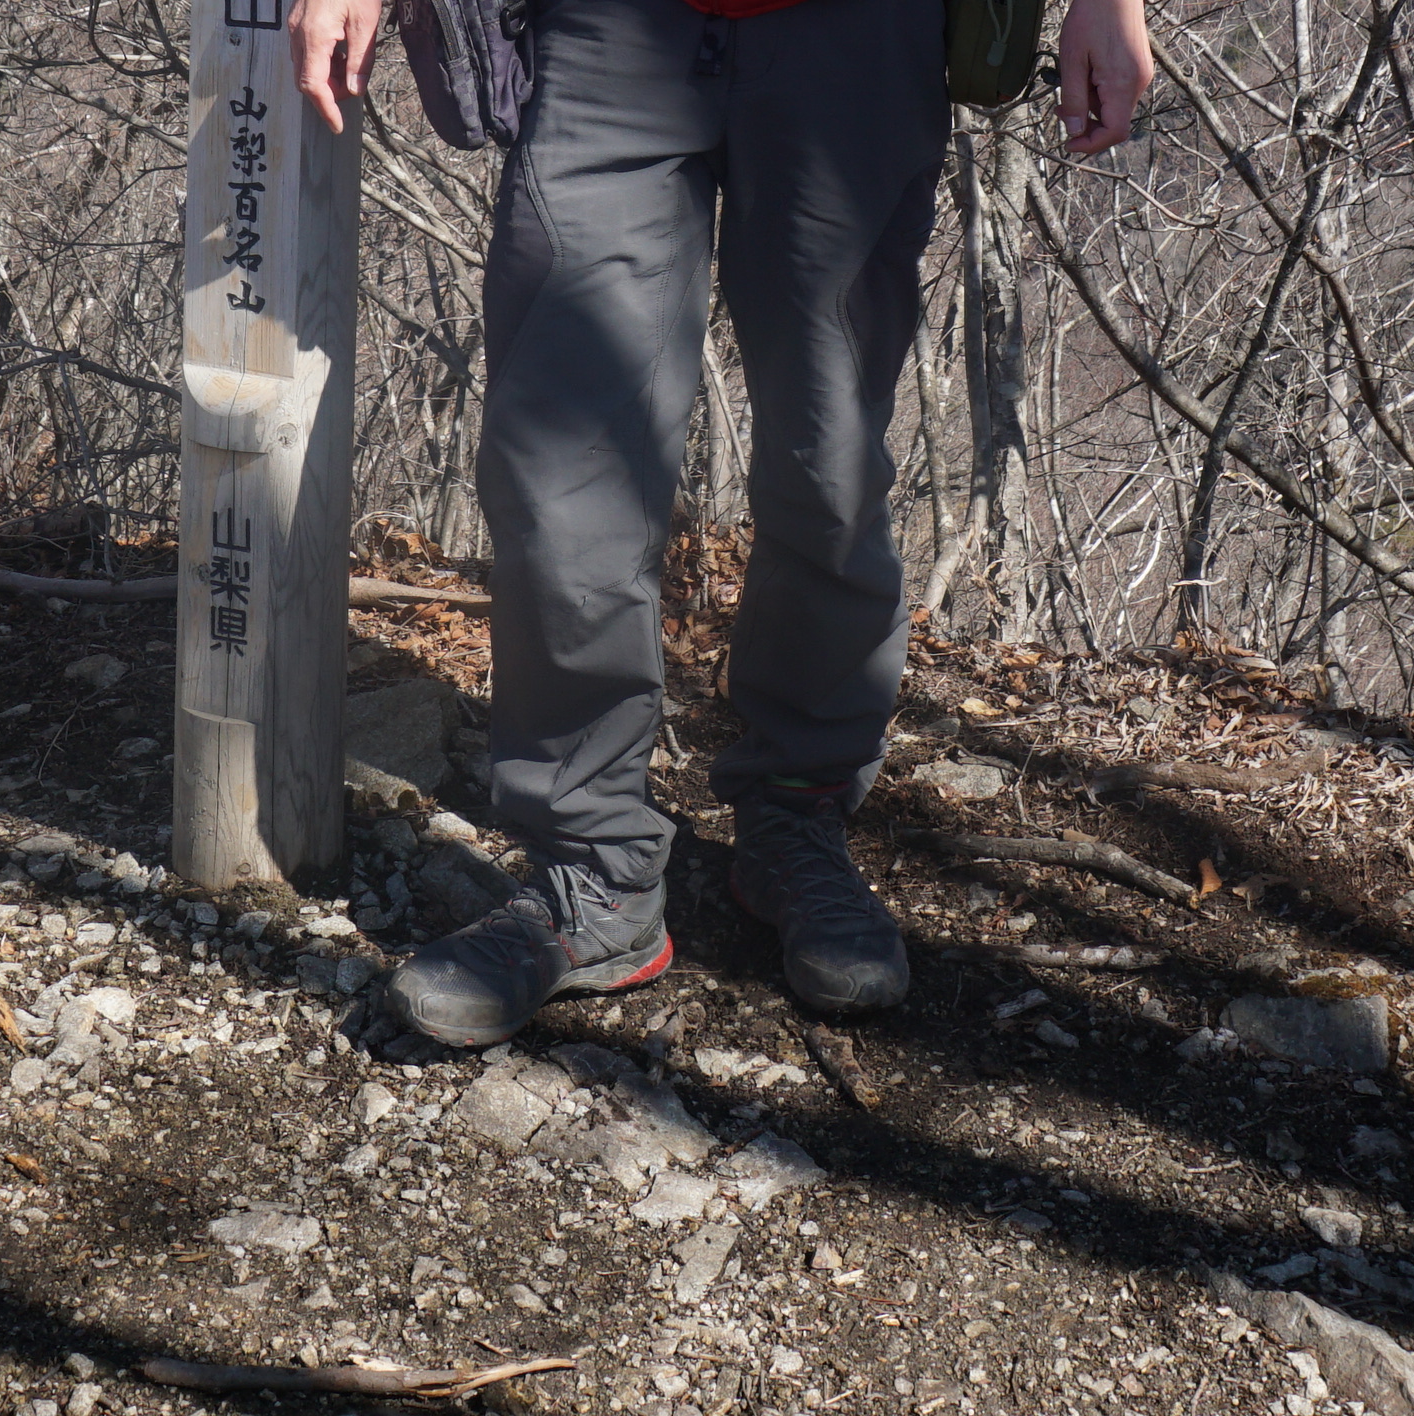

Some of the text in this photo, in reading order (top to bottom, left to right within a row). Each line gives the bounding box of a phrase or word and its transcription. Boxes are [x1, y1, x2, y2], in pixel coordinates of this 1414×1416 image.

[222, 86, 268, 315] 山梨百名山
[209, 507, 252, 658] 山梨県
